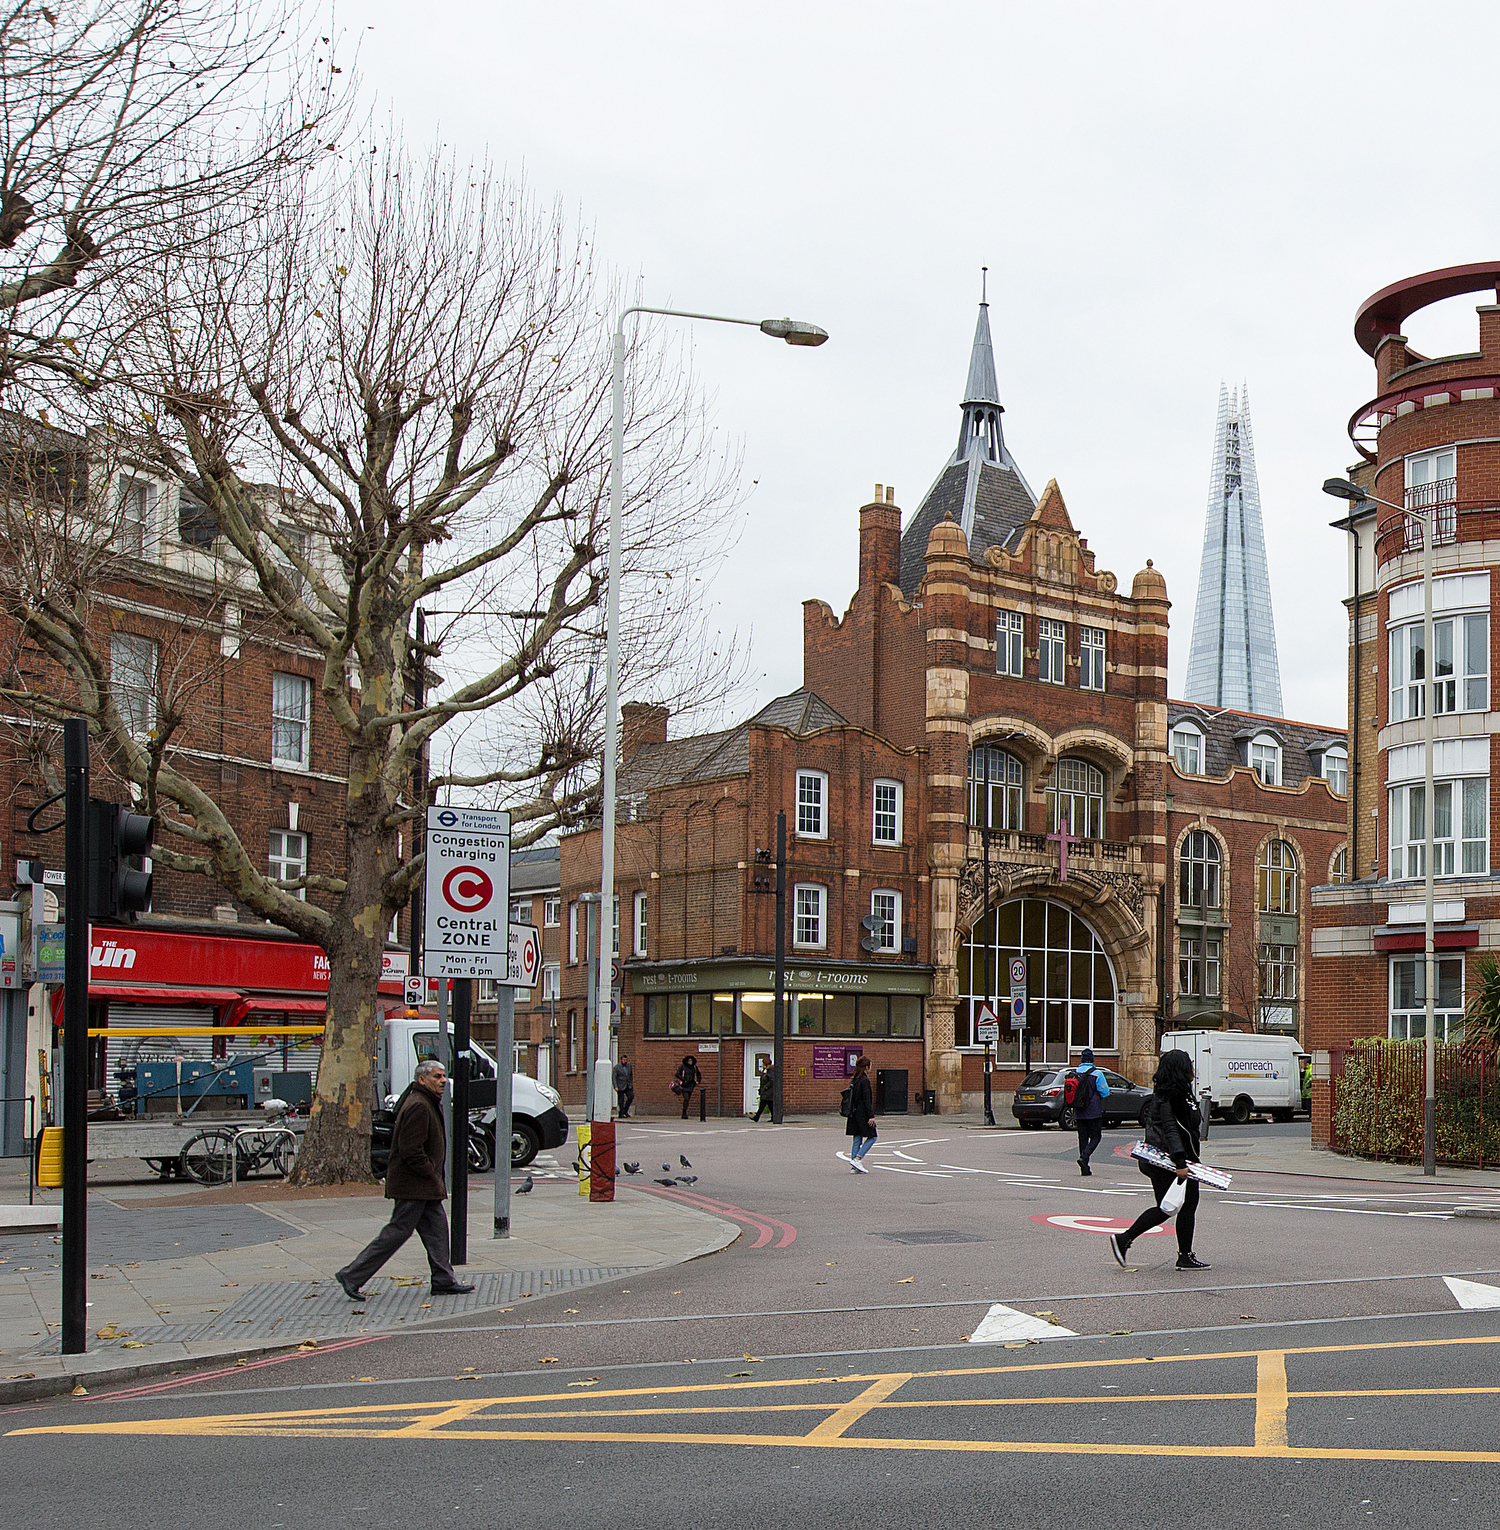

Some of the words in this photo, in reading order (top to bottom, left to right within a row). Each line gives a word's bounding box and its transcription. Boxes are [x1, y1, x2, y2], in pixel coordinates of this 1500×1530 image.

[462, 813, 498, 822] Transport
[474, 822, 501, 830] London
[432, 833, 505, 848] Congestion
[440, 848, 496, 862] charging
[44, 872, 62, 880] TOWER
[437, 916, 498, 931] Central
[442, 932, 491, 946] ZONE
[90, 946, 136, 968] un
[446, 955, 466, 964] Mon
[474, 956, 487, 964] Fri
[313, 971, 327, 980] NEWS
[768, 970, 795, 981] rst
[816, 970, 868, 984] t-rooms
[1013, 966, 1024, 976] 20
[642, 974, 657, 984] rest
[668, 972, 698, 983] t-rooms
[1228, 1060, 1273, 1072] openreach
